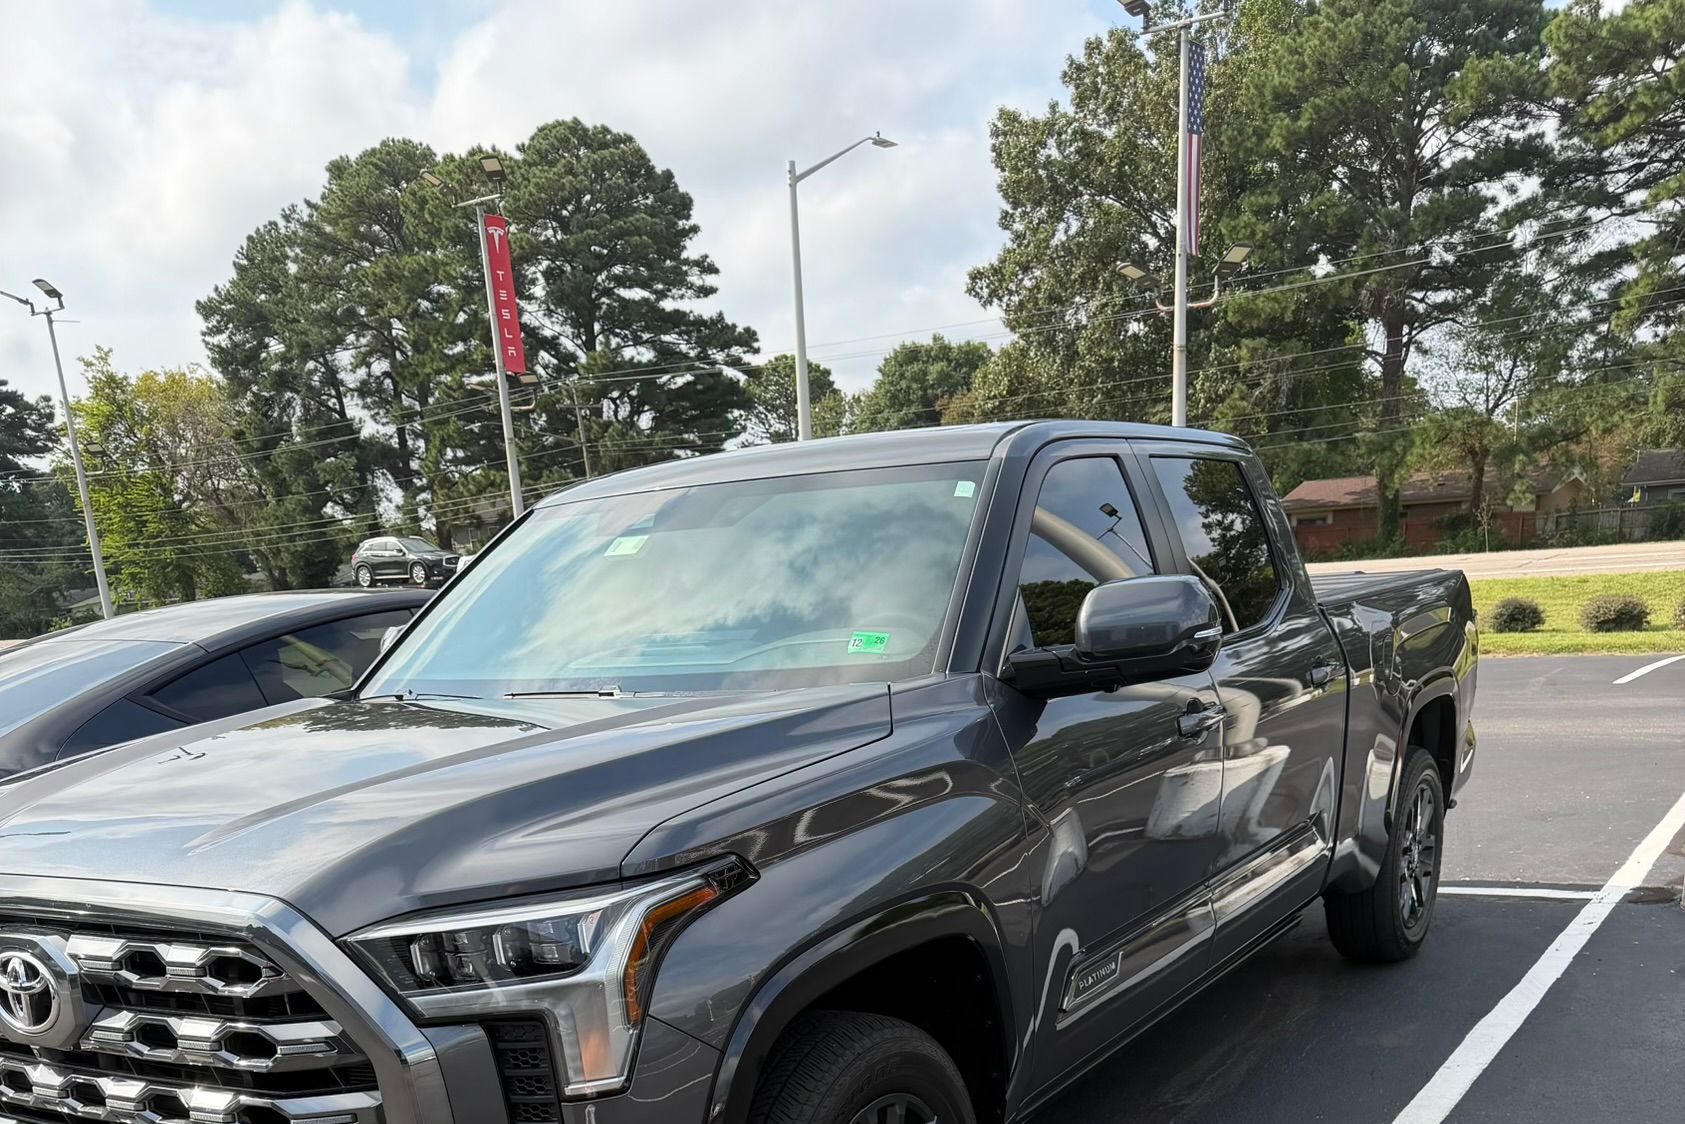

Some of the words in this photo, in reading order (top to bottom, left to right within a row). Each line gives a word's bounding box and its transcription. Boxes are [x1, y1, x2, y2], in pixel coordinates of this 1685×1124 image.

[496, 270, 517, 357] TESLA
[852, 638, 863, 648] 12
[874, 636, 886, 645] 26
[1078, 961, 1116, 990] PLATINUM
